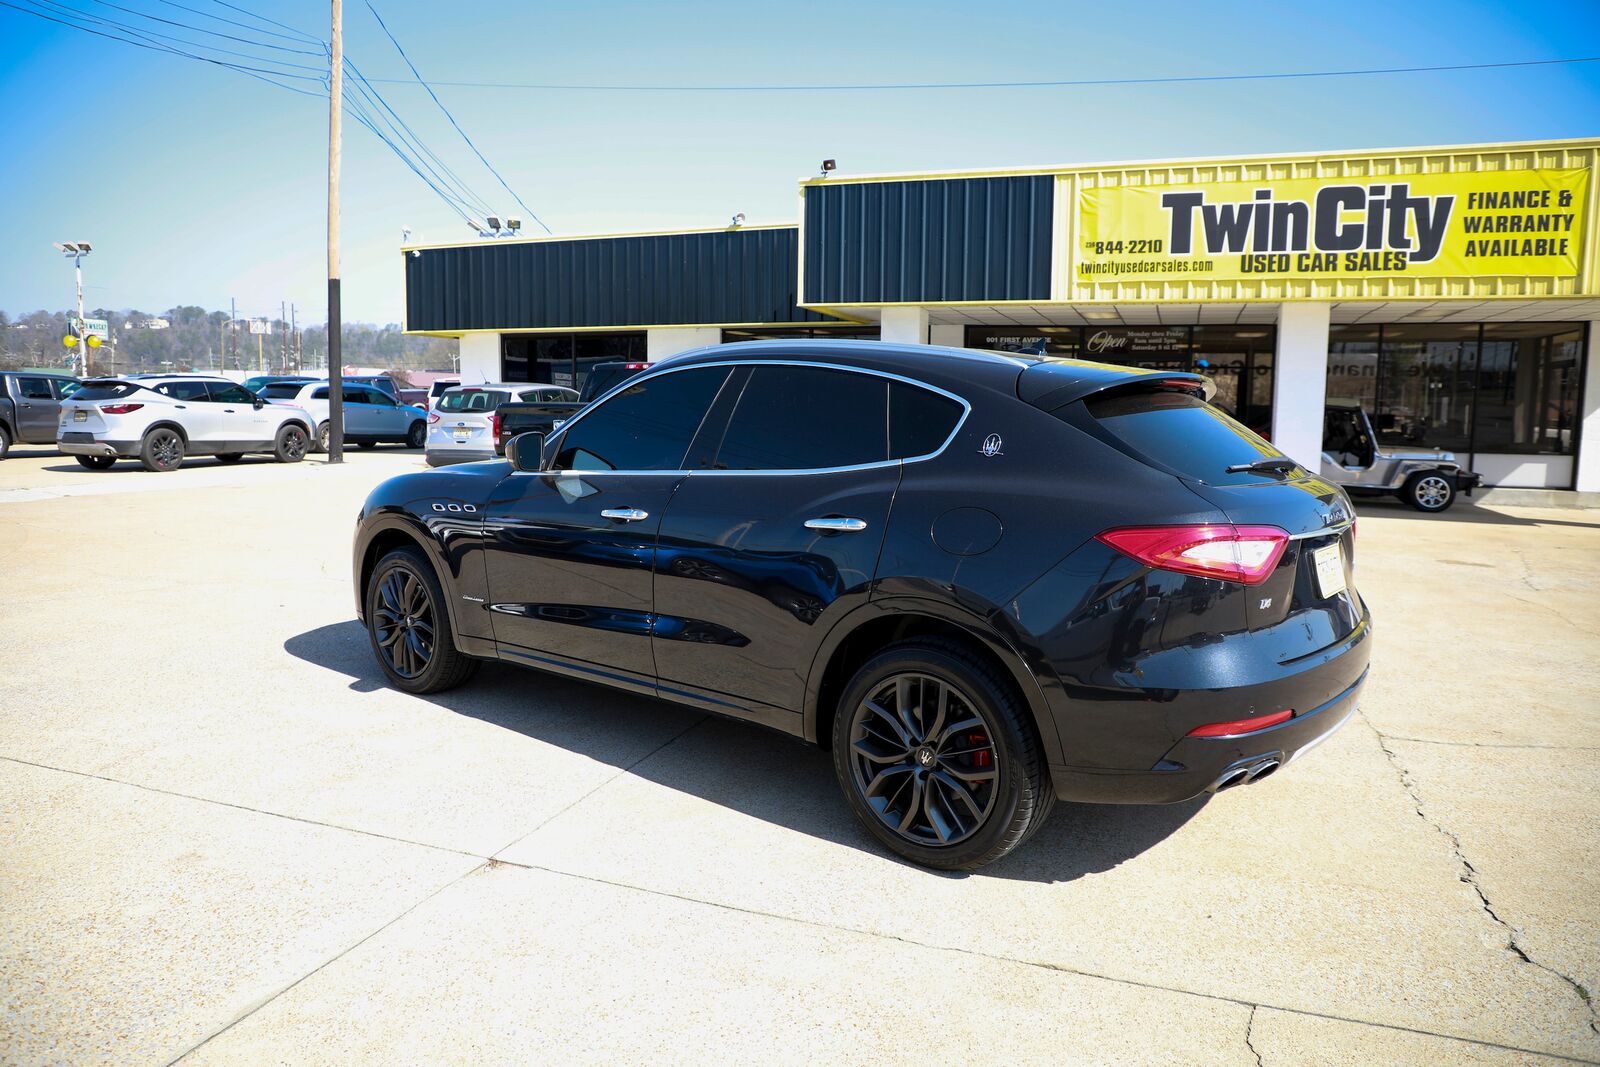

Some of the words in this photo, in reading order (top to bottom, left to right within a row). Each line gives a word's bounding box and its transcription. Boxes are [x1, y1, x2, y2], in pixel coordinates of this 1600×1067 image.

[1467, 190, 1551, 209] FINANCE
[1558, 190, 1573, 207] &
[1463, 214, 1575, 233] WARRANTY
[1465, 239, 1569, 257] AVAILABLE
[1081, 259, 1214, 276] twincityusedcarsales.com
[1240, 254, 1290, 273] USED
[1297, 253, 1338, 272] CAR
[1344, 251, 1407, 271] SALES
[1087, 330, 1128, 353] Open
